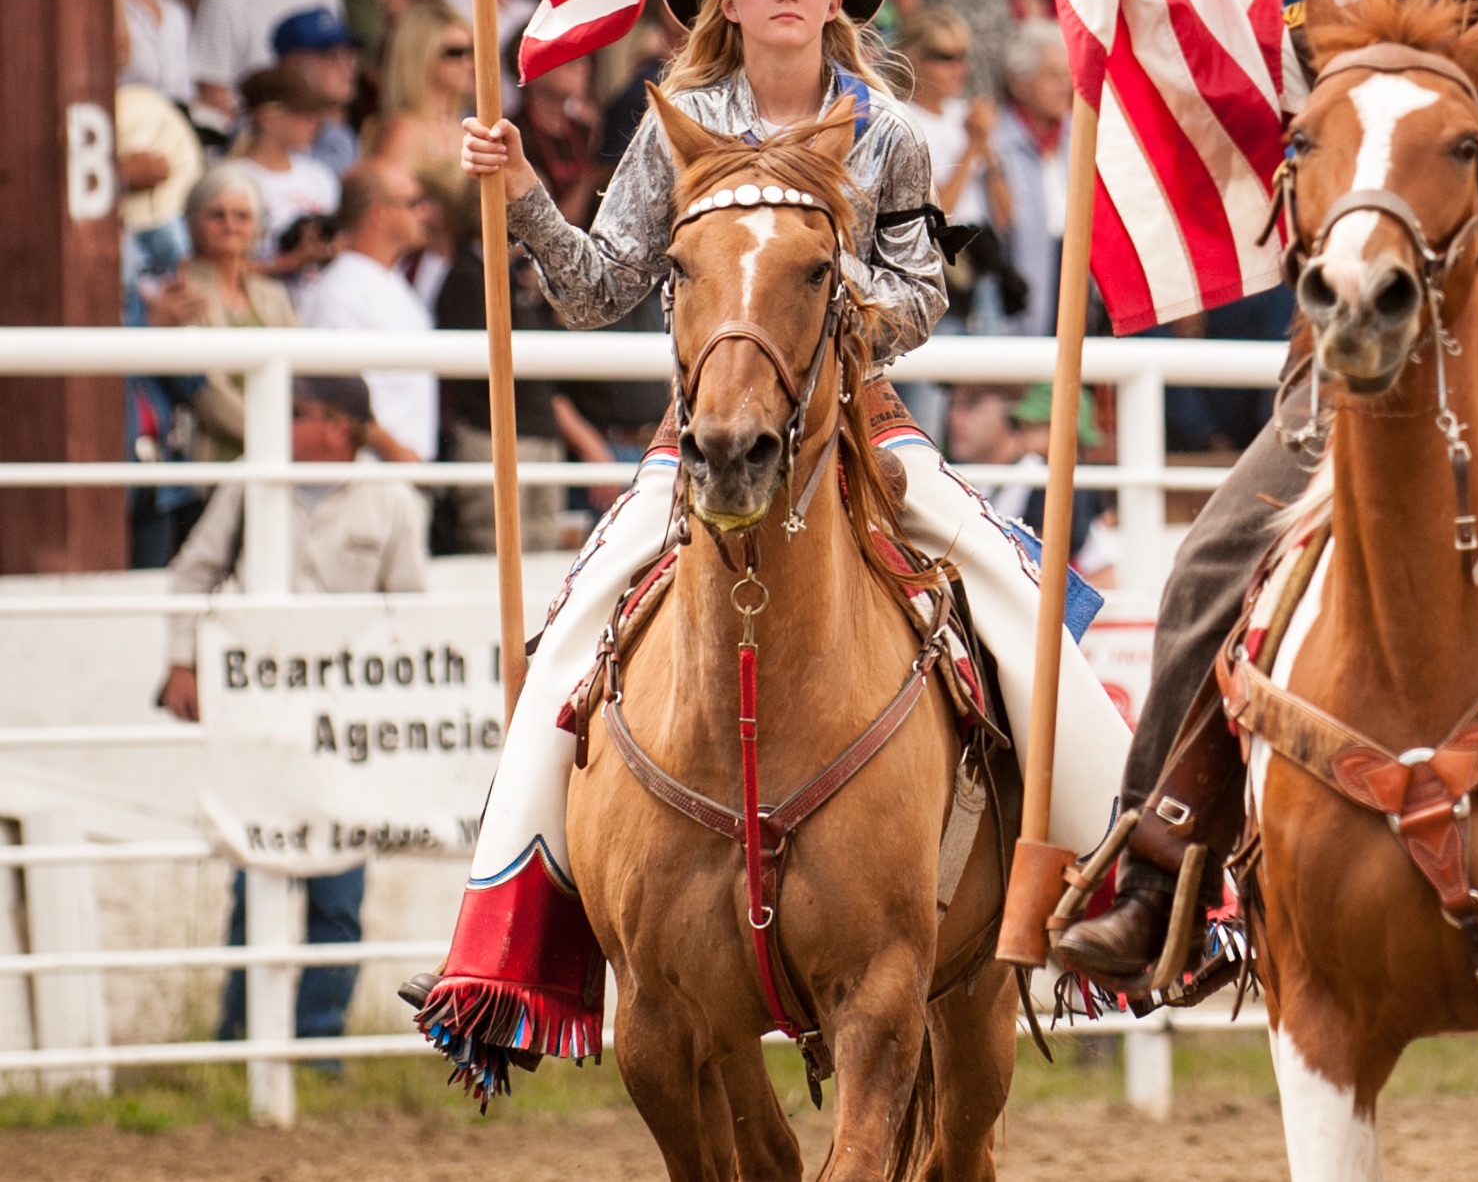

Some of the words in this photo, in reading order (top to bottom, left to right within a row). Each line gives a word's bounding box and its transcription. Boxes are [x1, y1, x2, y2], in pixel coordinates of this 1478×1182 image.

[66, 102, 115, 221] B
[223, 647, 465, 689] Beartooth
[247, 820, 310, 852] Red
